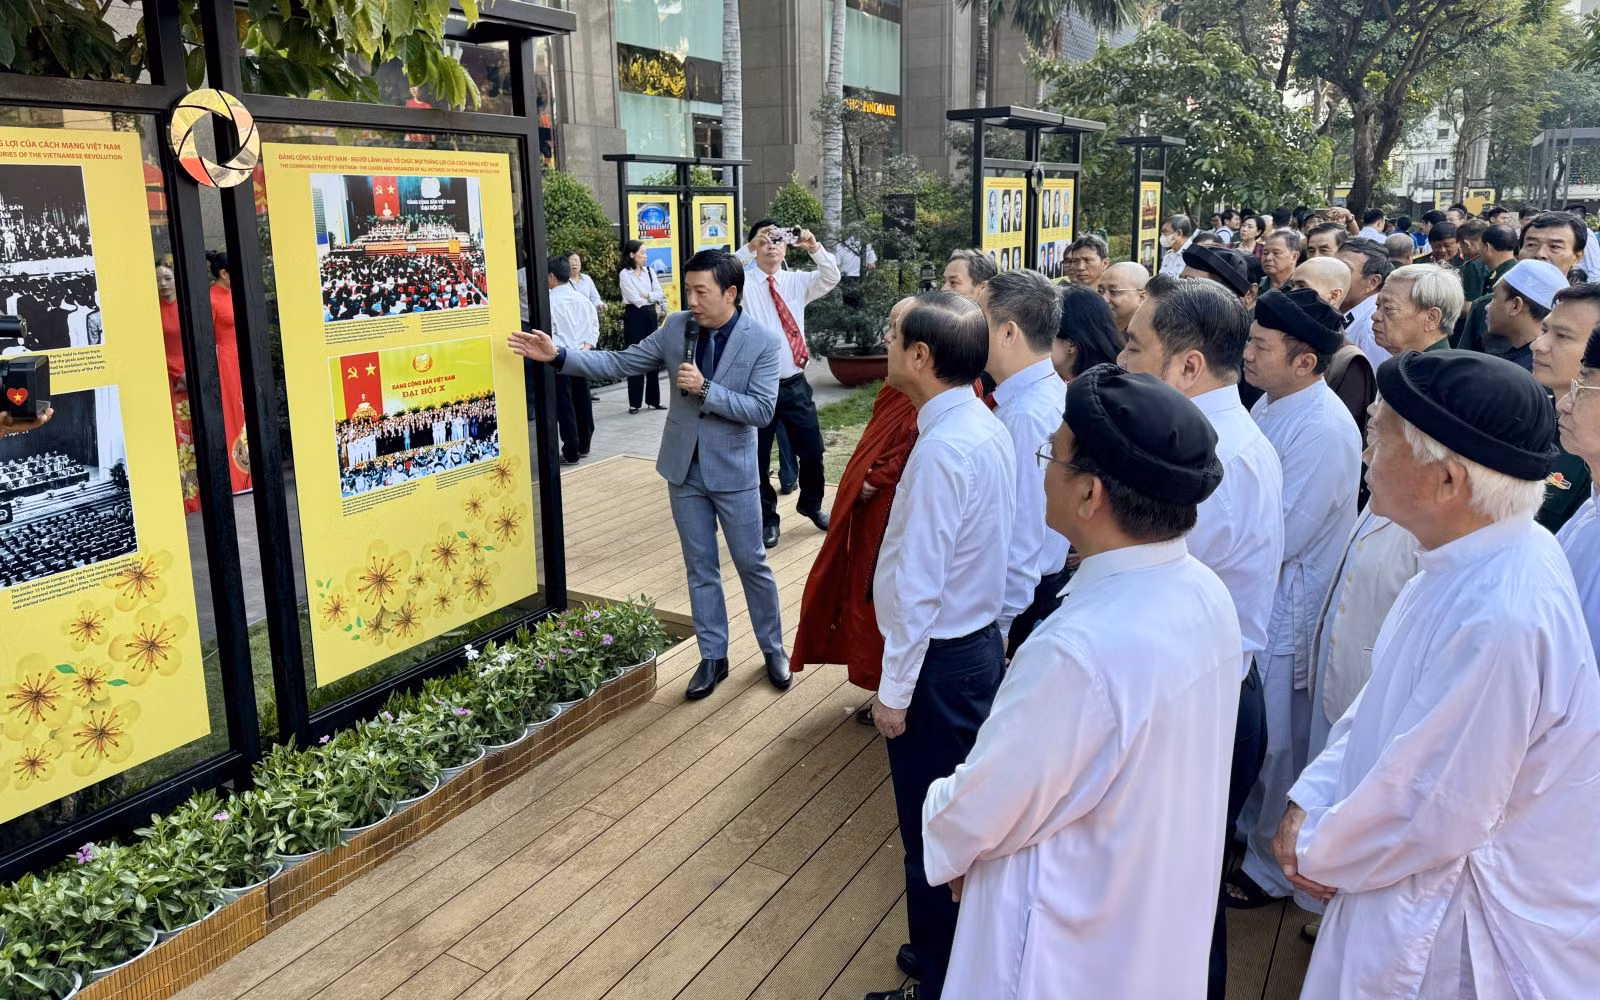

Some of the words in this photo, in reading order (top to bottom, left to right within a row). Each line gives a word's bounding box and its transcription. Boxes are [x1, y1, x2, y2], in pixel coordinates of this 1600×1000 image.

[5, 140, 18, 149] LỢI
[20, 138, 37, 148] CỦA
[39, 140, 60, 149] CÁCH
[61, 142, 85, 151] MẠNG
[86, 142, 102, 151] VIỆT
[402, 390, 418, 398] ĐẠI
[420, 385, 436, 395] HỘI
[51, 575, 70, 584] Congress
[12, 591, 34, 599] December
[46, 581, 68, 590] December
[57, 590, 76, 598] Secretary
[12, 596, 30, 604] national
